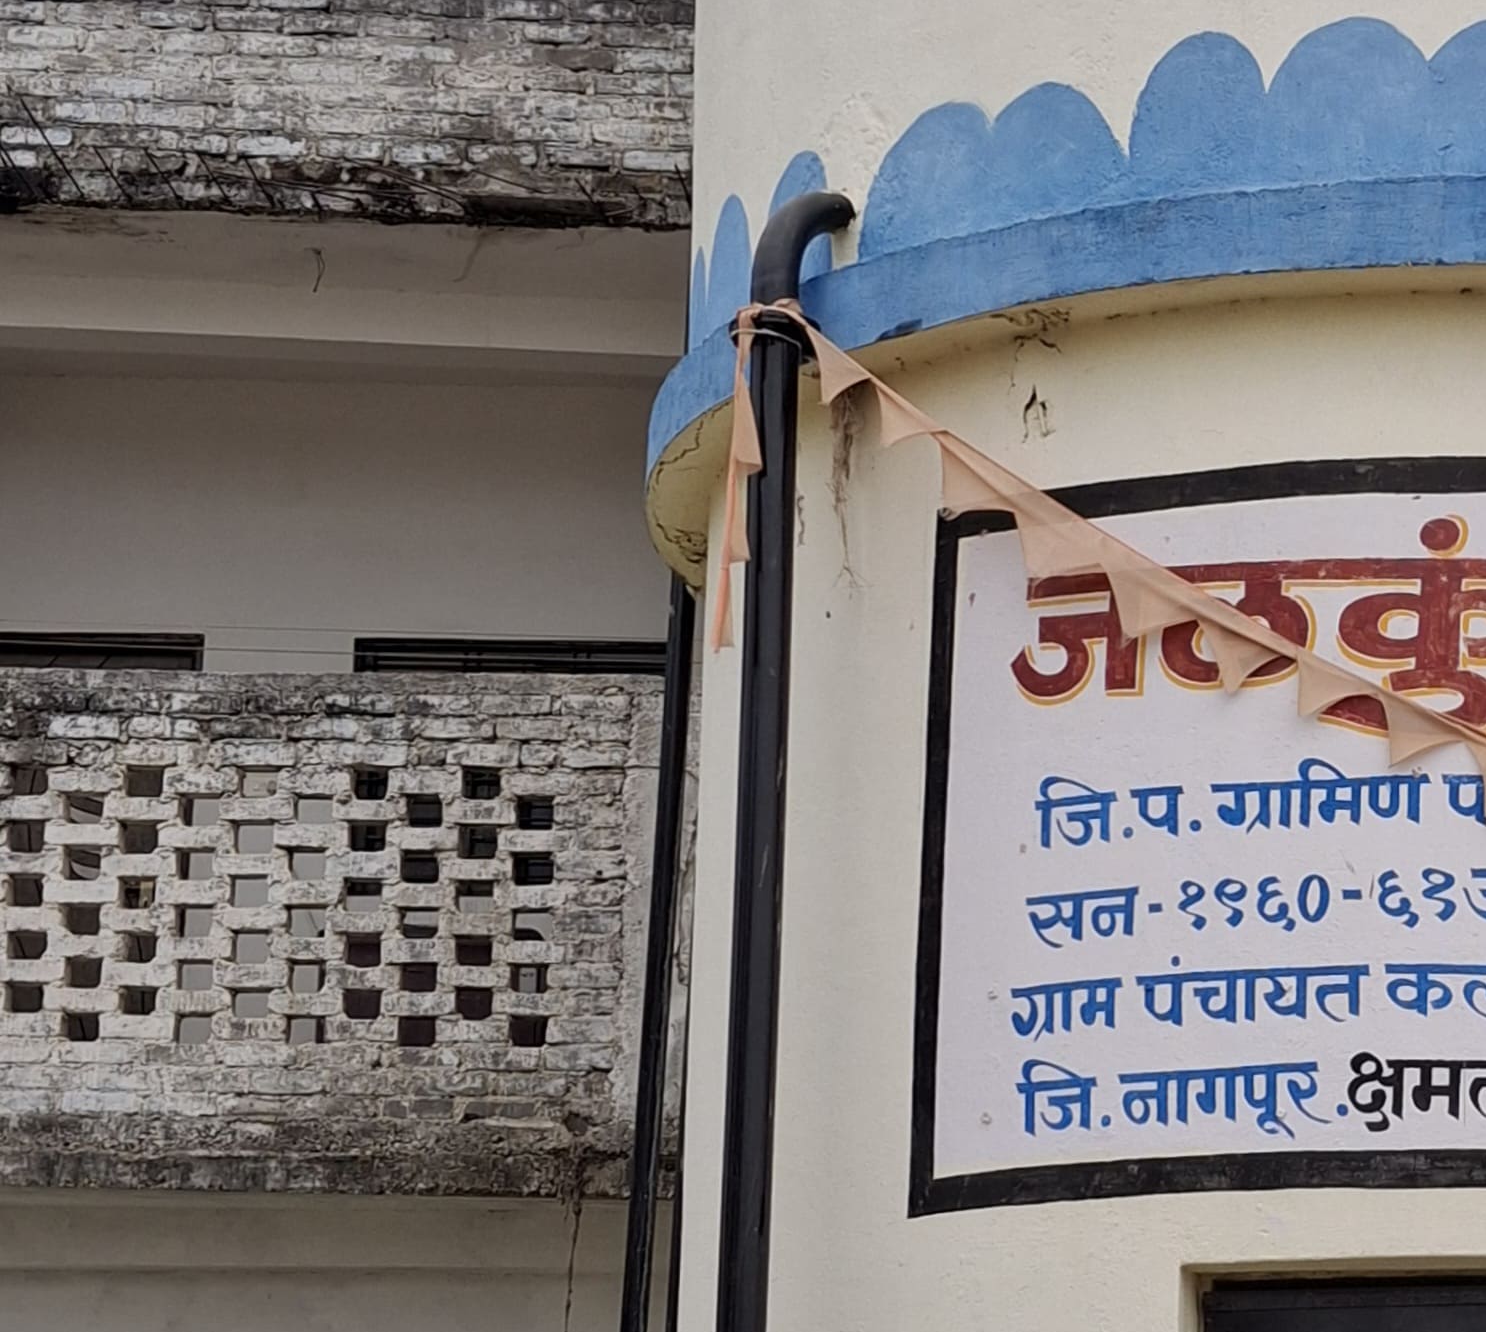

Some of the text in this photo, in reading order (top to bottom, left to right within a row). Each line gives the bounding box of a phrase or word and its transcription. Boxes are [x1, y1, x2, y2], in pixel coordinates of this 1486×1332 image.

[1211, 757, 1430, 834] ग्रामिण
[1011, 978, 1123, 1041] ग्राम
[1135, 955, 1370, 1027] पंचायत
